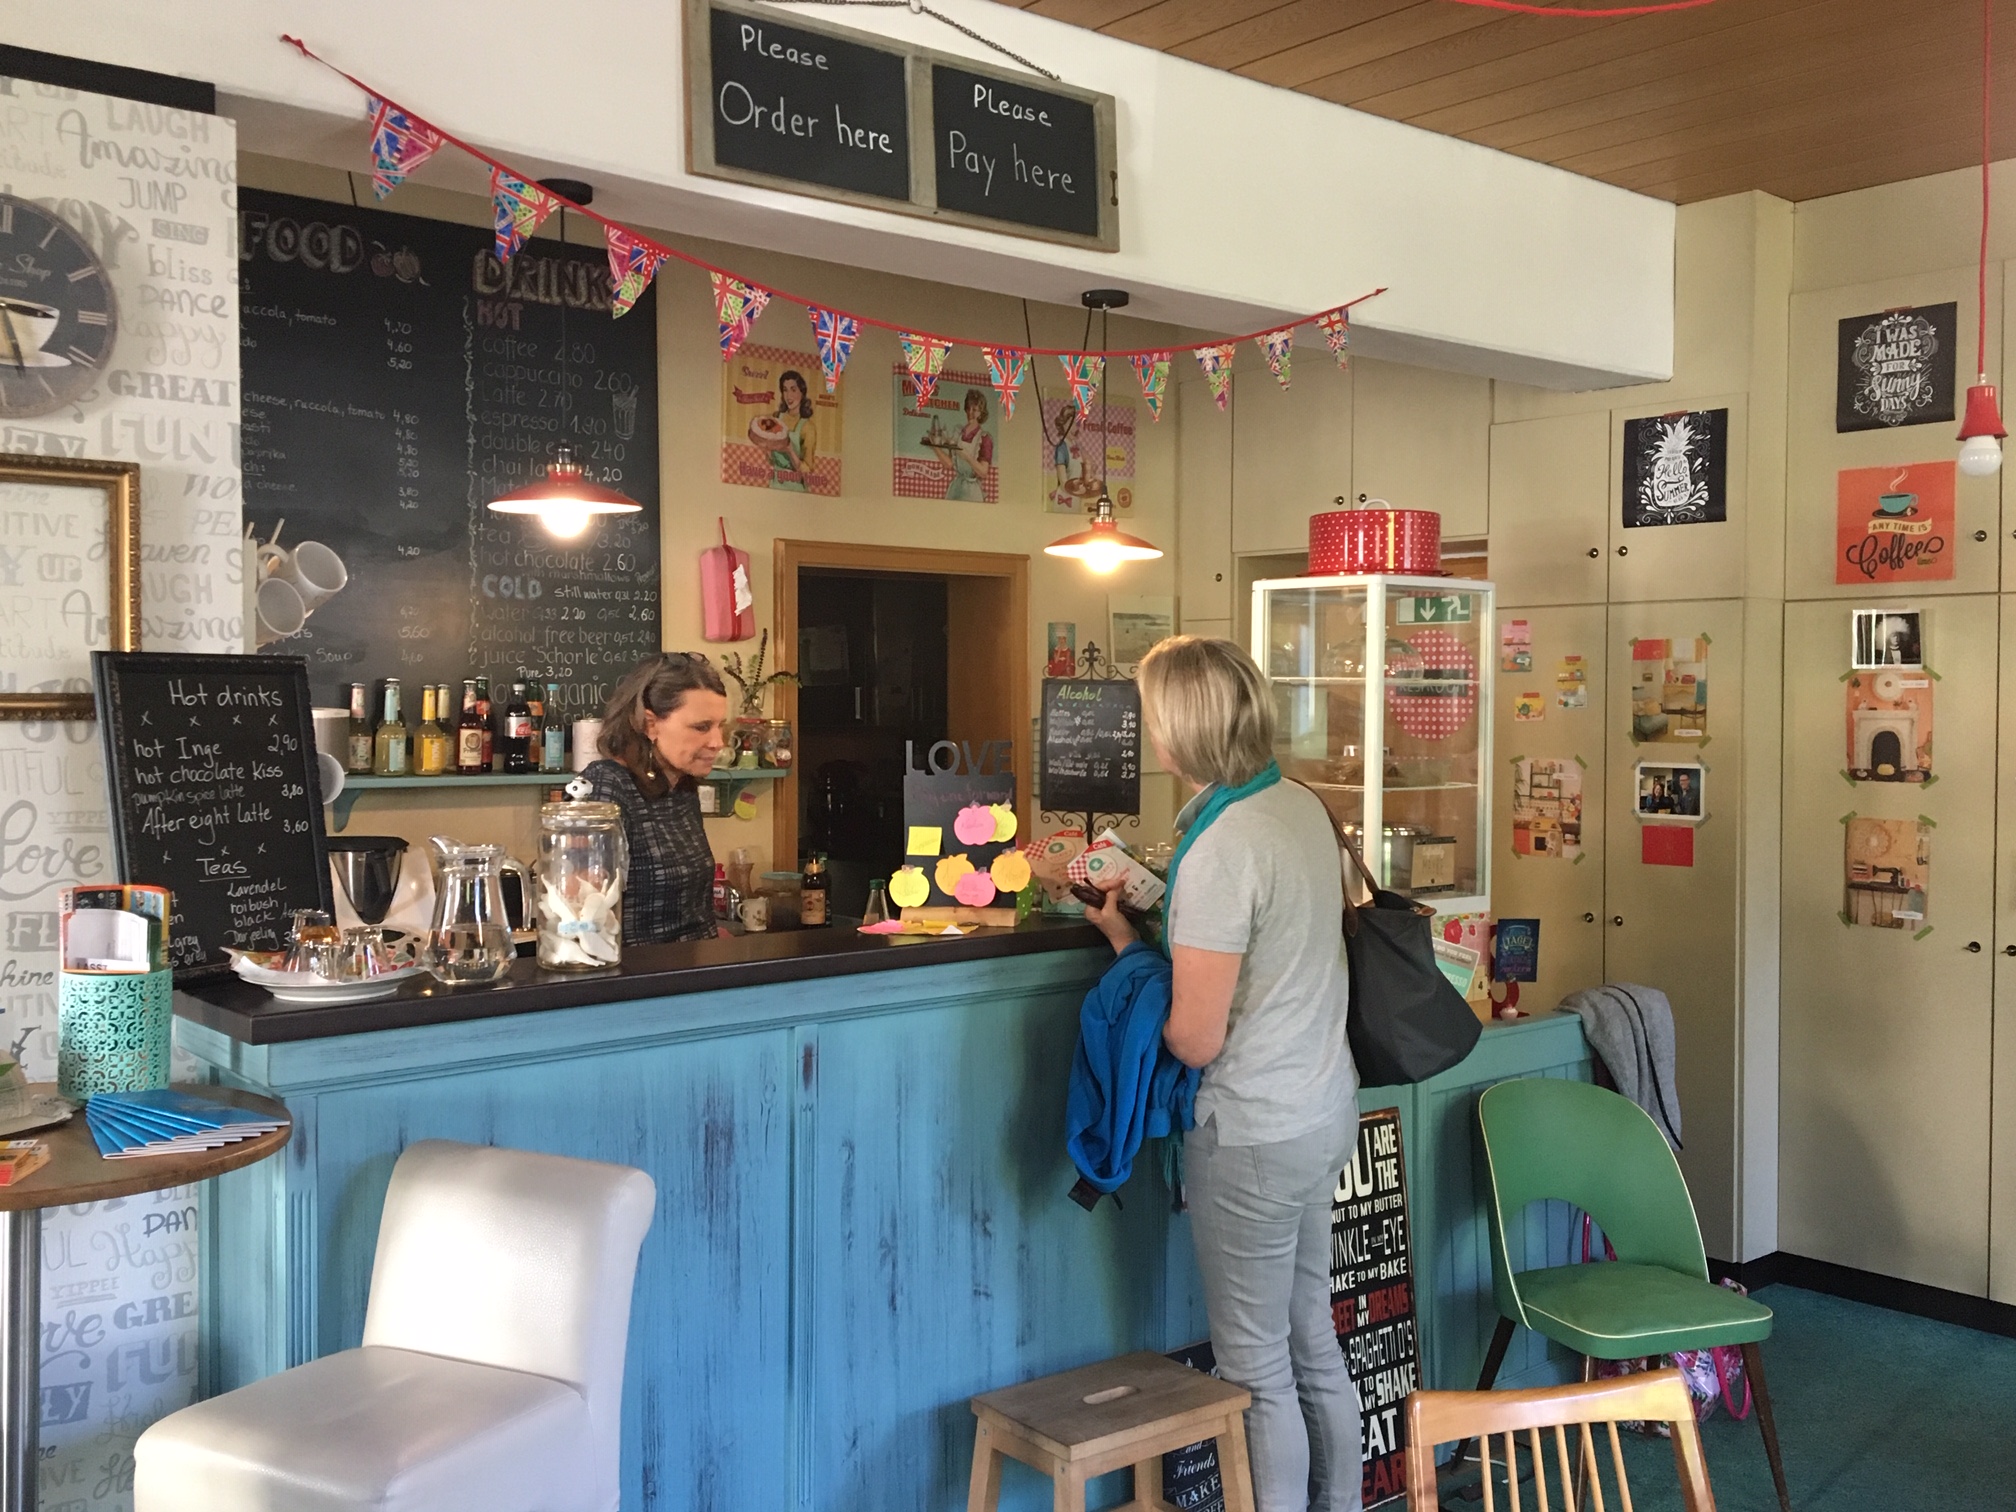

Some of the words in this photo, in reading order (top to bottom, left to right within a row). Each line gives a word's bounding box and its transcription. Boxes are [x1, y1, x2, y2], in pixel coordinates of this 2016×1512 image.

[740, 24, 829, 70] Please
[719, 81, 819, 138] Order
[835, 104, 893, 154] here
[973, 84, 1052, 127] Please
[949, 130, 995, 196] Pay
[1013, 143, 1076, 194] here
[117, 177, 188, 214] JUMP
[238, 210, 365, 273] FOOD
[146, 244, 213, 285] bliss
[476, 299, 523, 331] HOT
[1874, 325, 1881, 343] I
[1886, 325, 1918, 343] WAS
[1869, 339, 1922, 362] MADE
[1886, 361, 1906, 372] FOR
[107, 369, 237, 406] GREAT
[1864, 372, 1923, 402] Sunny
[1880, 394, 1908, 411] DAYS
[481, 409, 559, 433] espresso
[481, 433, 540, 455] double
[481, 457, 522, 477] chai
[1656, 459, 1688, 480] Hello
[478, 522, 512, 545] tea
[1872, 522, 1890, 531] ANY
[1893, 522, 1915, 533] TIME
[1918, 524, 1928, 532] IS
[514, 550, 594, 571] chocolate
[1846, 533, 1944, 580] Coffee
[482, 573, 543, 600] COLD
[554, 585, 582, 599] still
[584, 586, 614, 601] water
[481, 626, 536, 643] alcohol
[544, 627, 576, 648] free
[579, 626, 614, 645] beer
[479, 646, 526, 669] juice
[168, 679, 208, 706] Hot
[216, 686, 283, 707] drinks
[1056, 684, 1103, 701] Alcohol
[133, 738, 165, 759] hot
[175, 737, 223, 768] Inge
[905, 739, 1013, 776] LOVE
[134, 766, 164, 785] hot
[170, 762, 246, 785] chocolate
[131, 789, 187, 813] pumpkin
[141, 808, 184, 840] After
[188, 805, 231, 845] eight
[195, 857, 248, 876] Teas
[230, 897, 279, 915] roibush
[233, 910, 275, 929] black
[1373, 1123, 1398, 1158] ARE
[1375, 1158, 1399, 1192] THE
[1348, 1205, 1359, 1220] TO
[1360, 1201, 1372, 1217] MY
[1374, 1193, 1403, 1214] BUTTER
[1383, 1215, 1406, 1256] EYE
[1356, 1270, 1366, 1283] TO
[1367, 1267, 1379, 1280] MY
[1380, 1257, 1407, 1280] BAKE
[1358, 1294, 1367, 1311] IN
[1357, 1310, 1370, 1328] MY
[1363, 1376, 1375, 1393] TO
[1376, 1362, 1417, 1407] SHAKE
[1364, 1394, 1376, 1412] MY
[1173, 1452, 1216, 1480] Friends
[1175, 1473, 1221, 1508] MAKE
